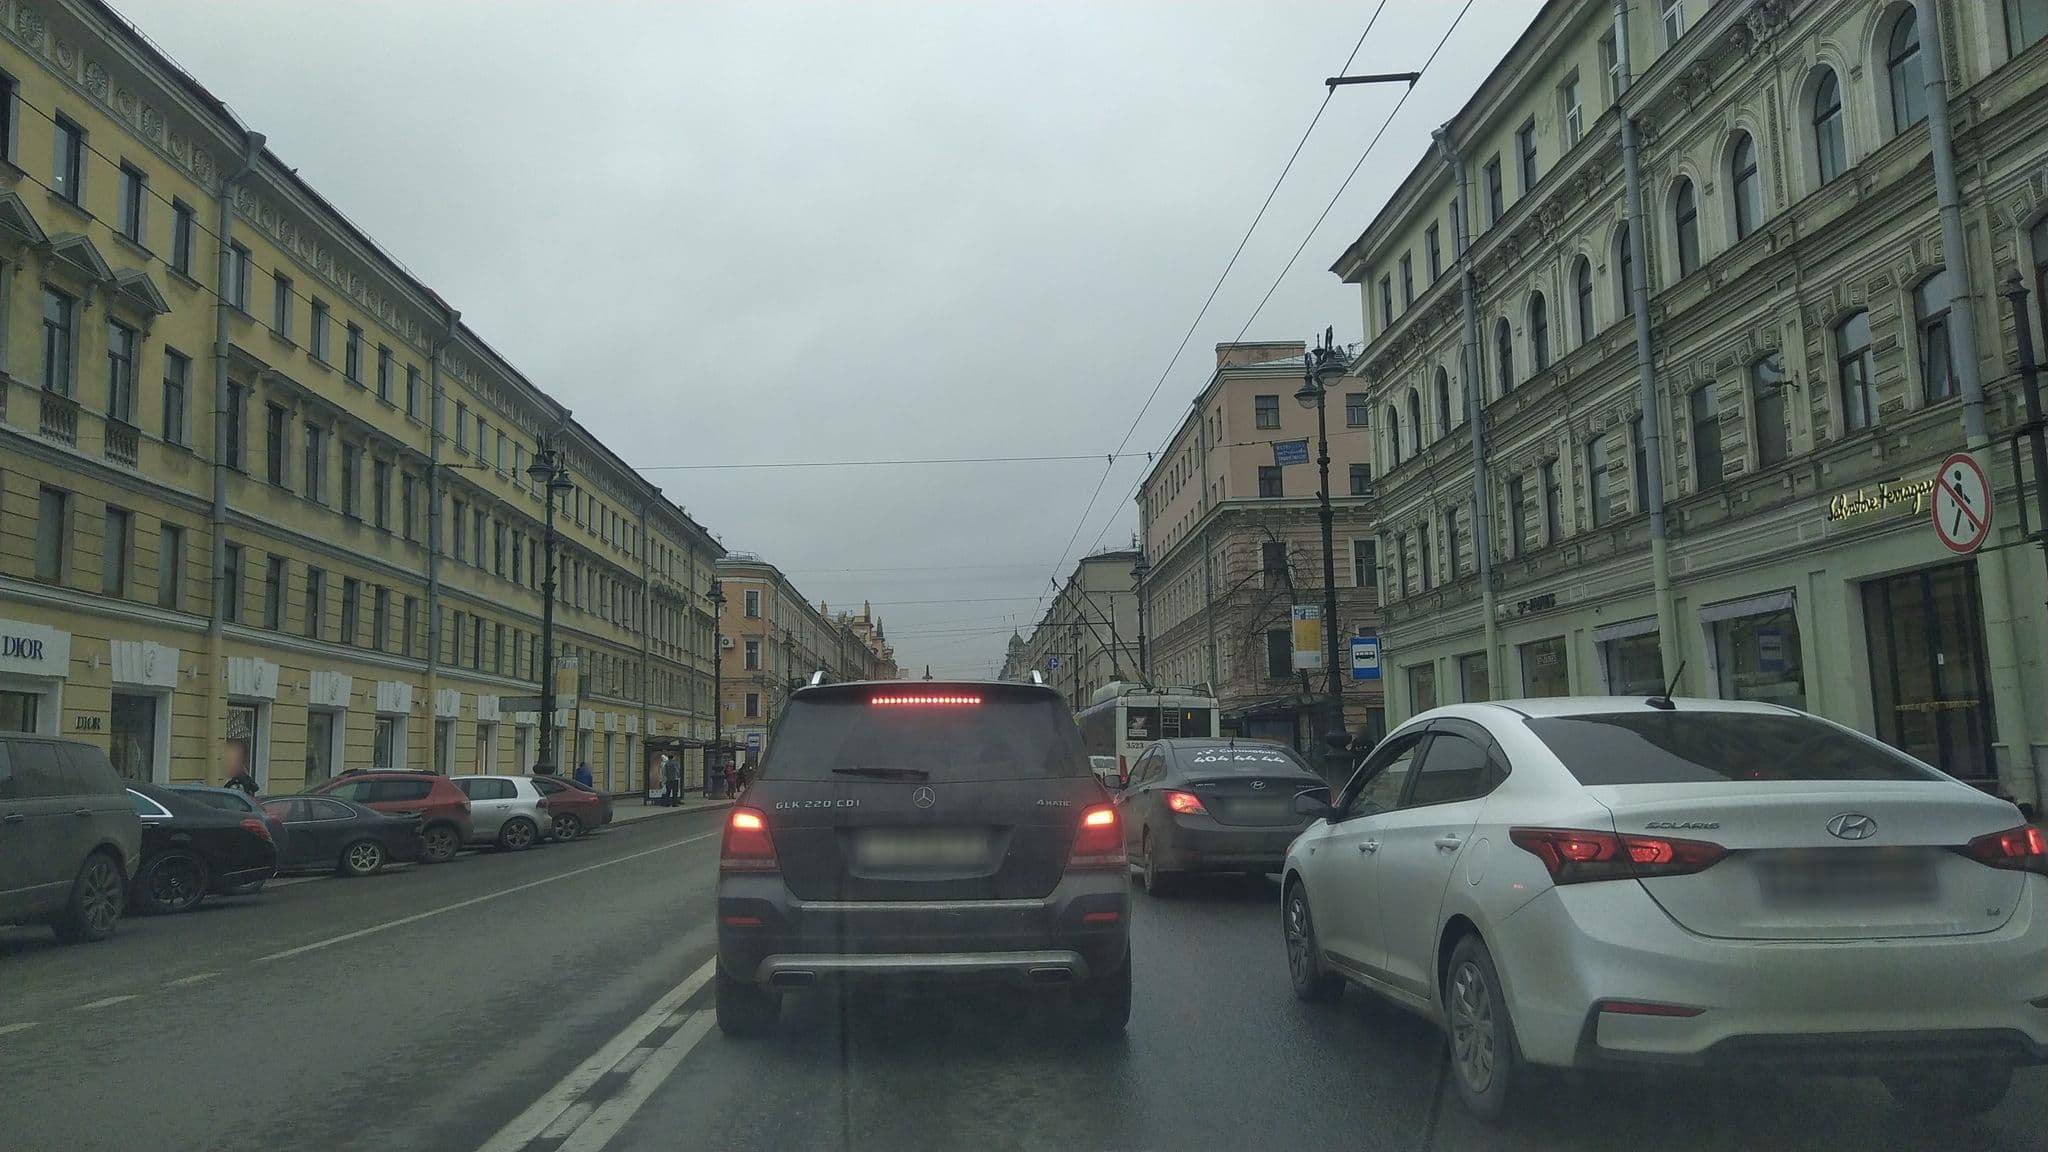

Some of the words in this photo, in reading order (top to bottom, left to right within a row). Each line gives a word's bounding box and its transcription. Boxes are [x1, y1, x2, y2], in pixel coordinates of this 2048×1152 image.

[1828, 489, 1879, 521] Salvatore
[2, 635, 43, 660] DIOR
[75, 716, 101, 730] DIOR
[1194, 755, 1229, 763] 404
[1261, 755, 1285, 763] 44
[775, 801, 800, 809] GLK
[804, 800, 832, 808] 220
[836, 799, 860, 807] CDI
[1645, 822, 1720, 830] SOLARIS
